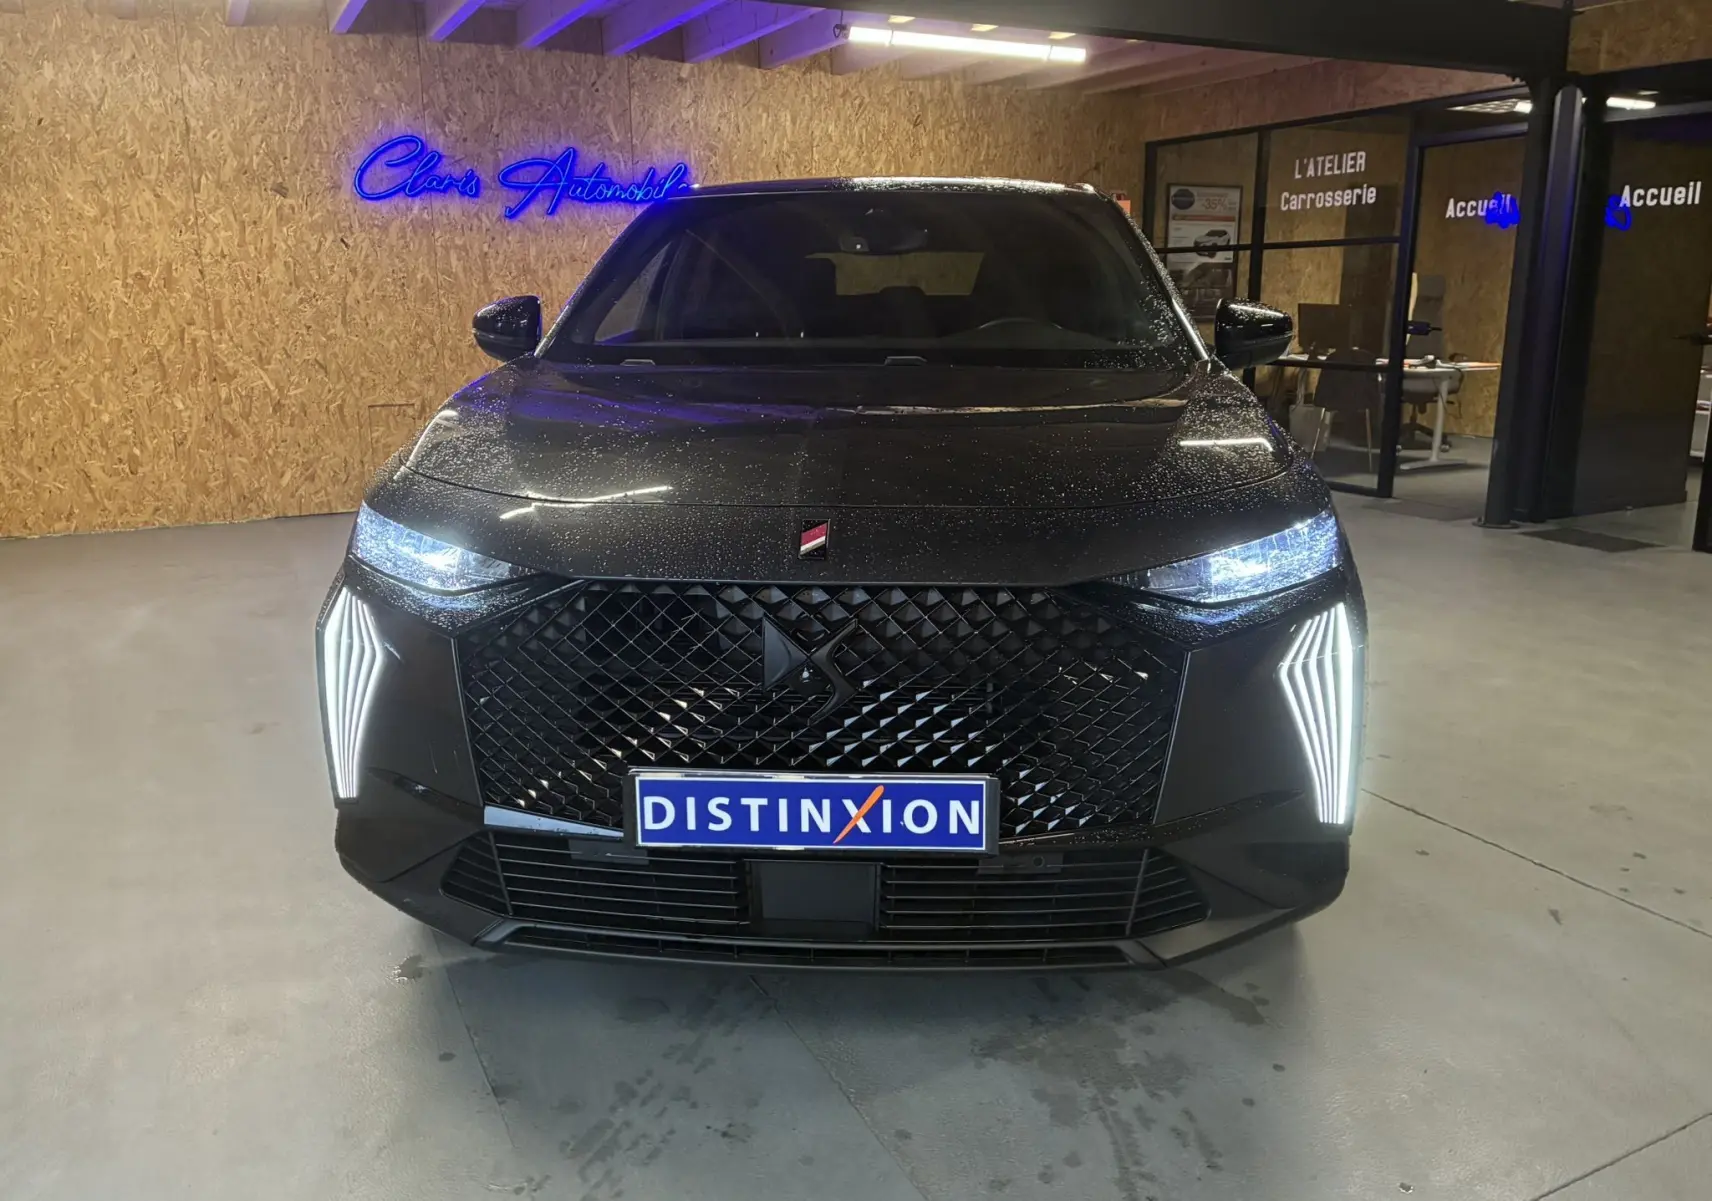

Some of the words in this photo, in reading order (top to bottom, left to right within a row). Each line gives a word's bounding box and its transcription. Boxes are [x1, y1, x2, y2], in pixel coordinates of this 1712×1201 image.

[354, 135, 480, 200] Claris
[499, 147, 690, 218] Automobil
[1294, 151, 1367, 179] L'ATELIER
[1280, 183, 1377, 211] Carrosserie
[1446, 193, 1511, 218] Accueil
[1619, 181, 1702, 208] Accueil
[643, 785, 980, 844] DISTINXION
